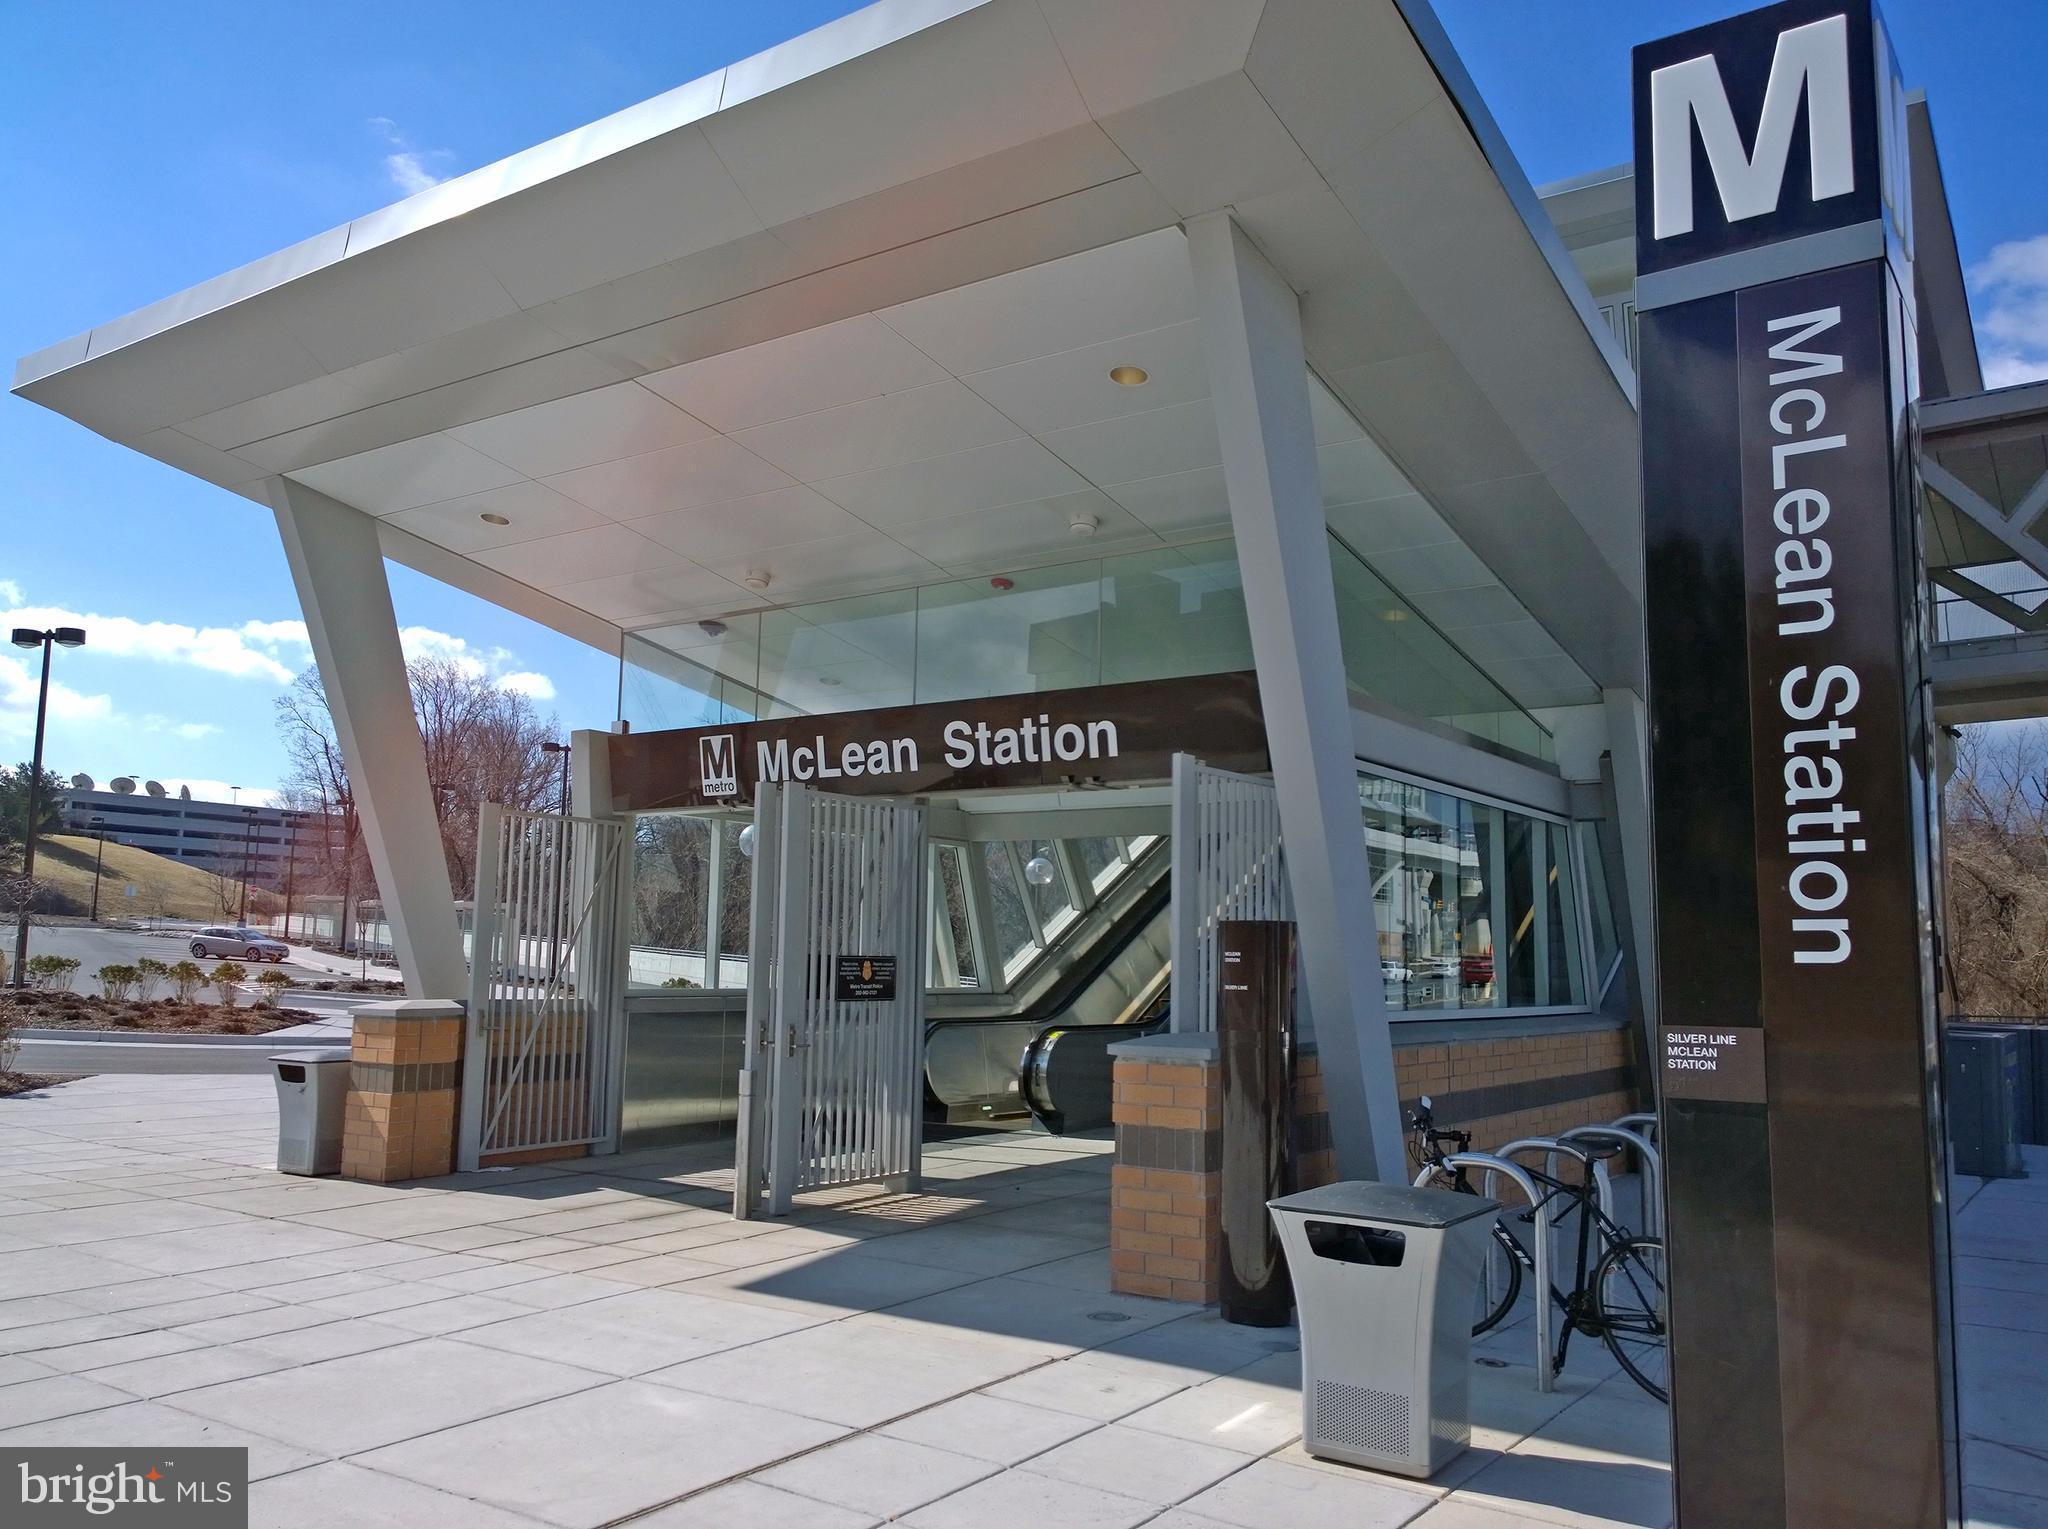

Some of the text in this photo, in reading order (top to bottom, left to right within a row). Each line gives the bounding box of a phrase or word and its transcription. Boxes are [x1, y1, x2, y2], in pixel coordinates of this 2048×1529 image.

[1651, 14, 1855, 240] M
[1767, 306, 1867, 964] McLean Station
[757, 714, 1119, 782] McLean Station
[704, 782, 735, 793] metro
[1667, 1033, 1737, 1045] SILVER LINE
[1667, 1046, 1718, 1057] MCLEAN
[1668, 1059, 1717, 1070] STATION
